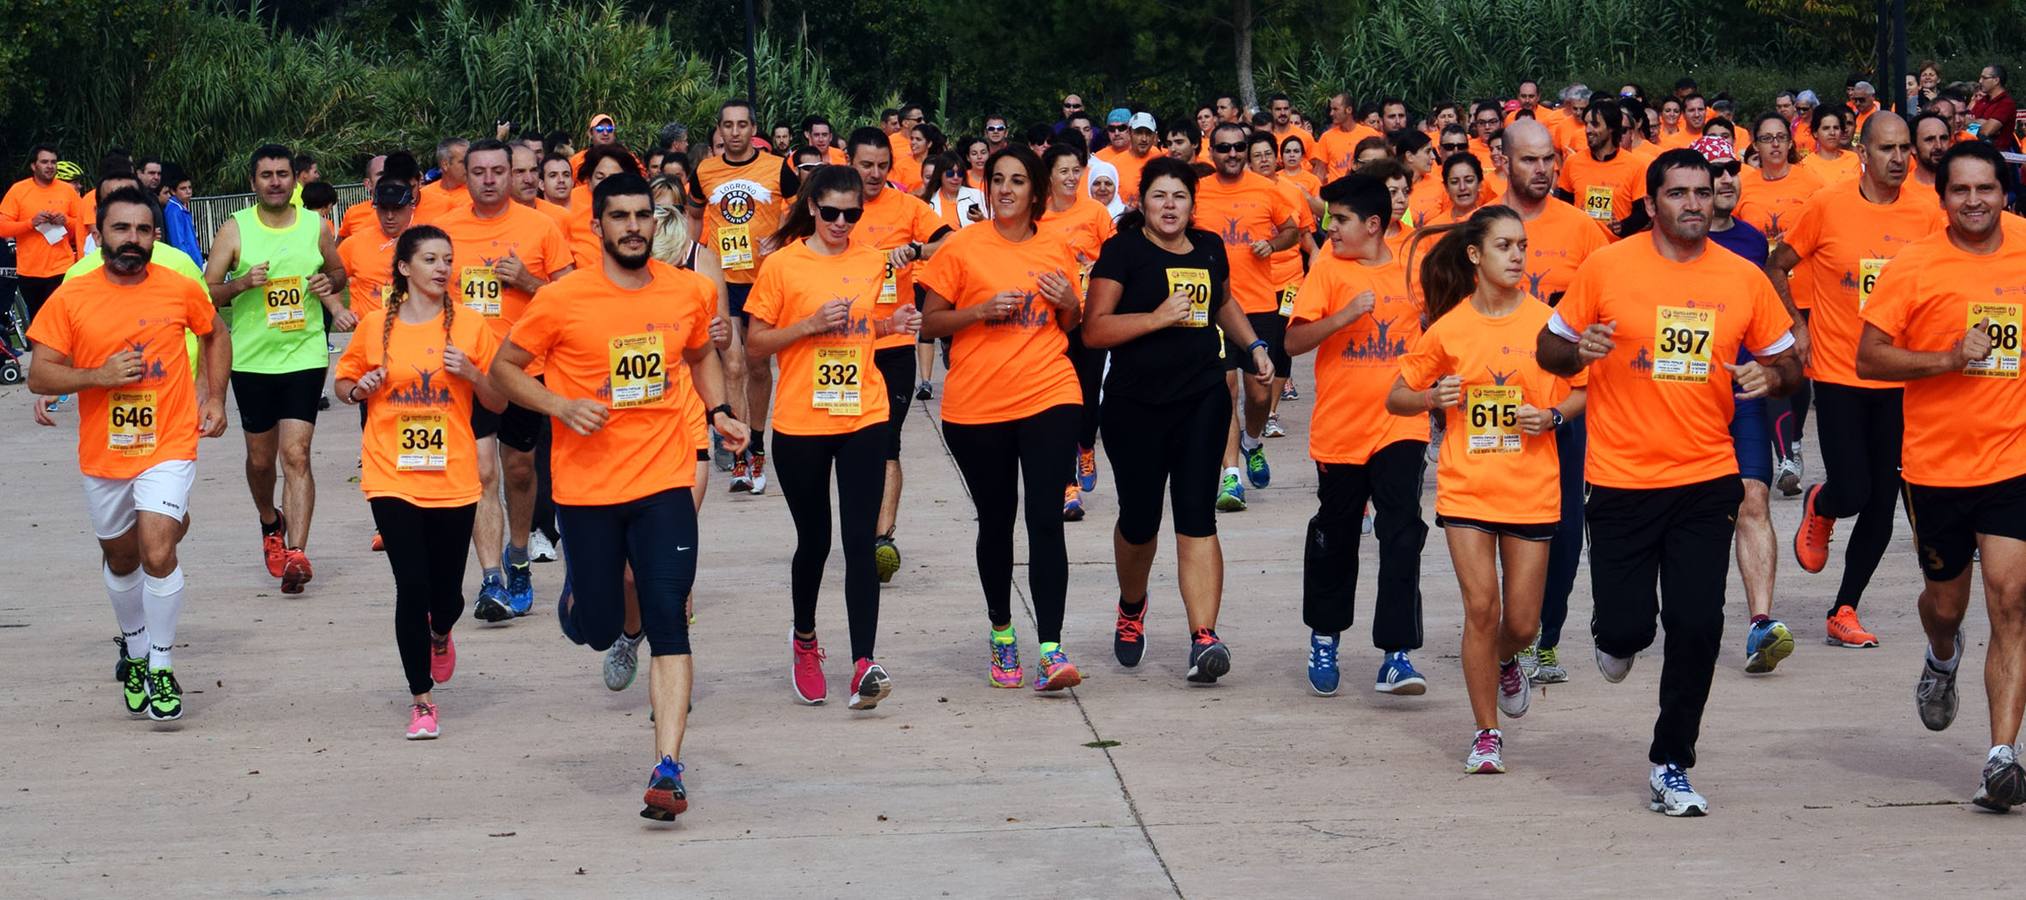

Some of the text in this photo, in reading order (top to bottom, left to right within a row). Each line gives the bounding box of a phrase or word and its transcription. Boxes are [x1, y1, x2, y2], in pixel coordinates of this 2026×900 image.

[720, 182, 757, 196] LOGROÑO
[726, 191, 749, 199] BEER
[1587, 195, 1611, 209] 437
[722, 209, 754, 224] RUNNERS
[721, 235, 749, 252] 614
[267, 288, 300, 308] 620
[464, 280, 499, 299] 419
[1660, 327, 1710, 355] 397
[1972, 323, 2018, 350] 98
[615, 352, 662, 381] 402
[817, 364, 858, 386] 332
[112, 406, 153, 428] 646
[1471, 403, 1517, 428] 615
[401, 428, 444, 450] 334
